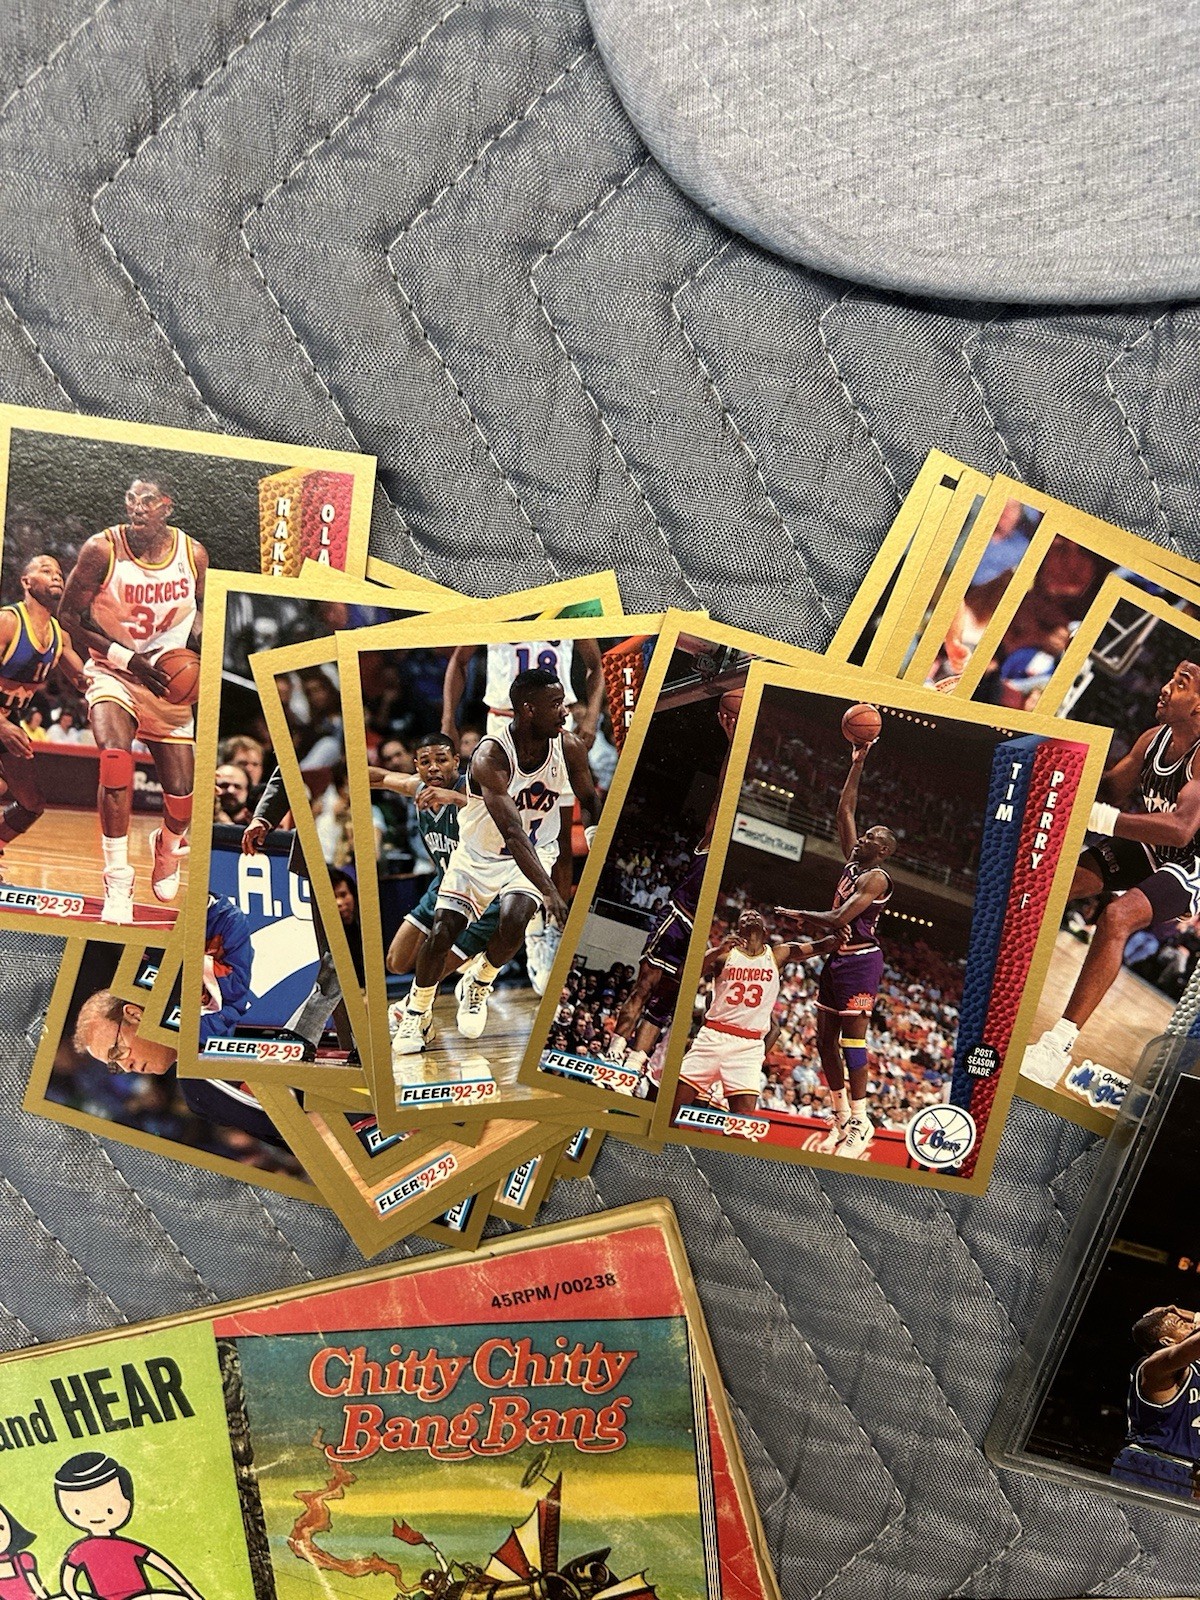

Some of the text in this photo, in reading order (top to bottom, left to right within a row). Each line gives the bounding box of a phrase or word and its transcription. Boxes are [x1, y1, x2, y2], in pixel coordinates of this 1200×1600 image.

[129, 605, 179, 640] 34
[516, 648, 558, 676] 18
[994, 762, 1023, 823] TIM
[1019, 770, 1066, 910] PERRY F
[725, 981, 764, 1008] 33
[207, 1040, 257, 1054] FLEER
[974, 1047, 993, 1058] POST
[548, 1053, 596, 1076] FLEER
[967, 1055, 995, 1068] SEASON
[967, 1065, 991, 1077] TRADE
[403, 1087, 451, 1102] FLEER
[679, 1109, 726, 1127] FLEER
[917, 1125, 962, 1150] 76ers
[378, 1178, 420, 1211] FLEER
[490, 1272, 618, 1310] 45RPM/00238
[308, 1335, 638, 1403] Chitty Chitty
[49, 1356, 196, 1440] HEAR
[324, 1395, 633, 1463] Bang Bang
